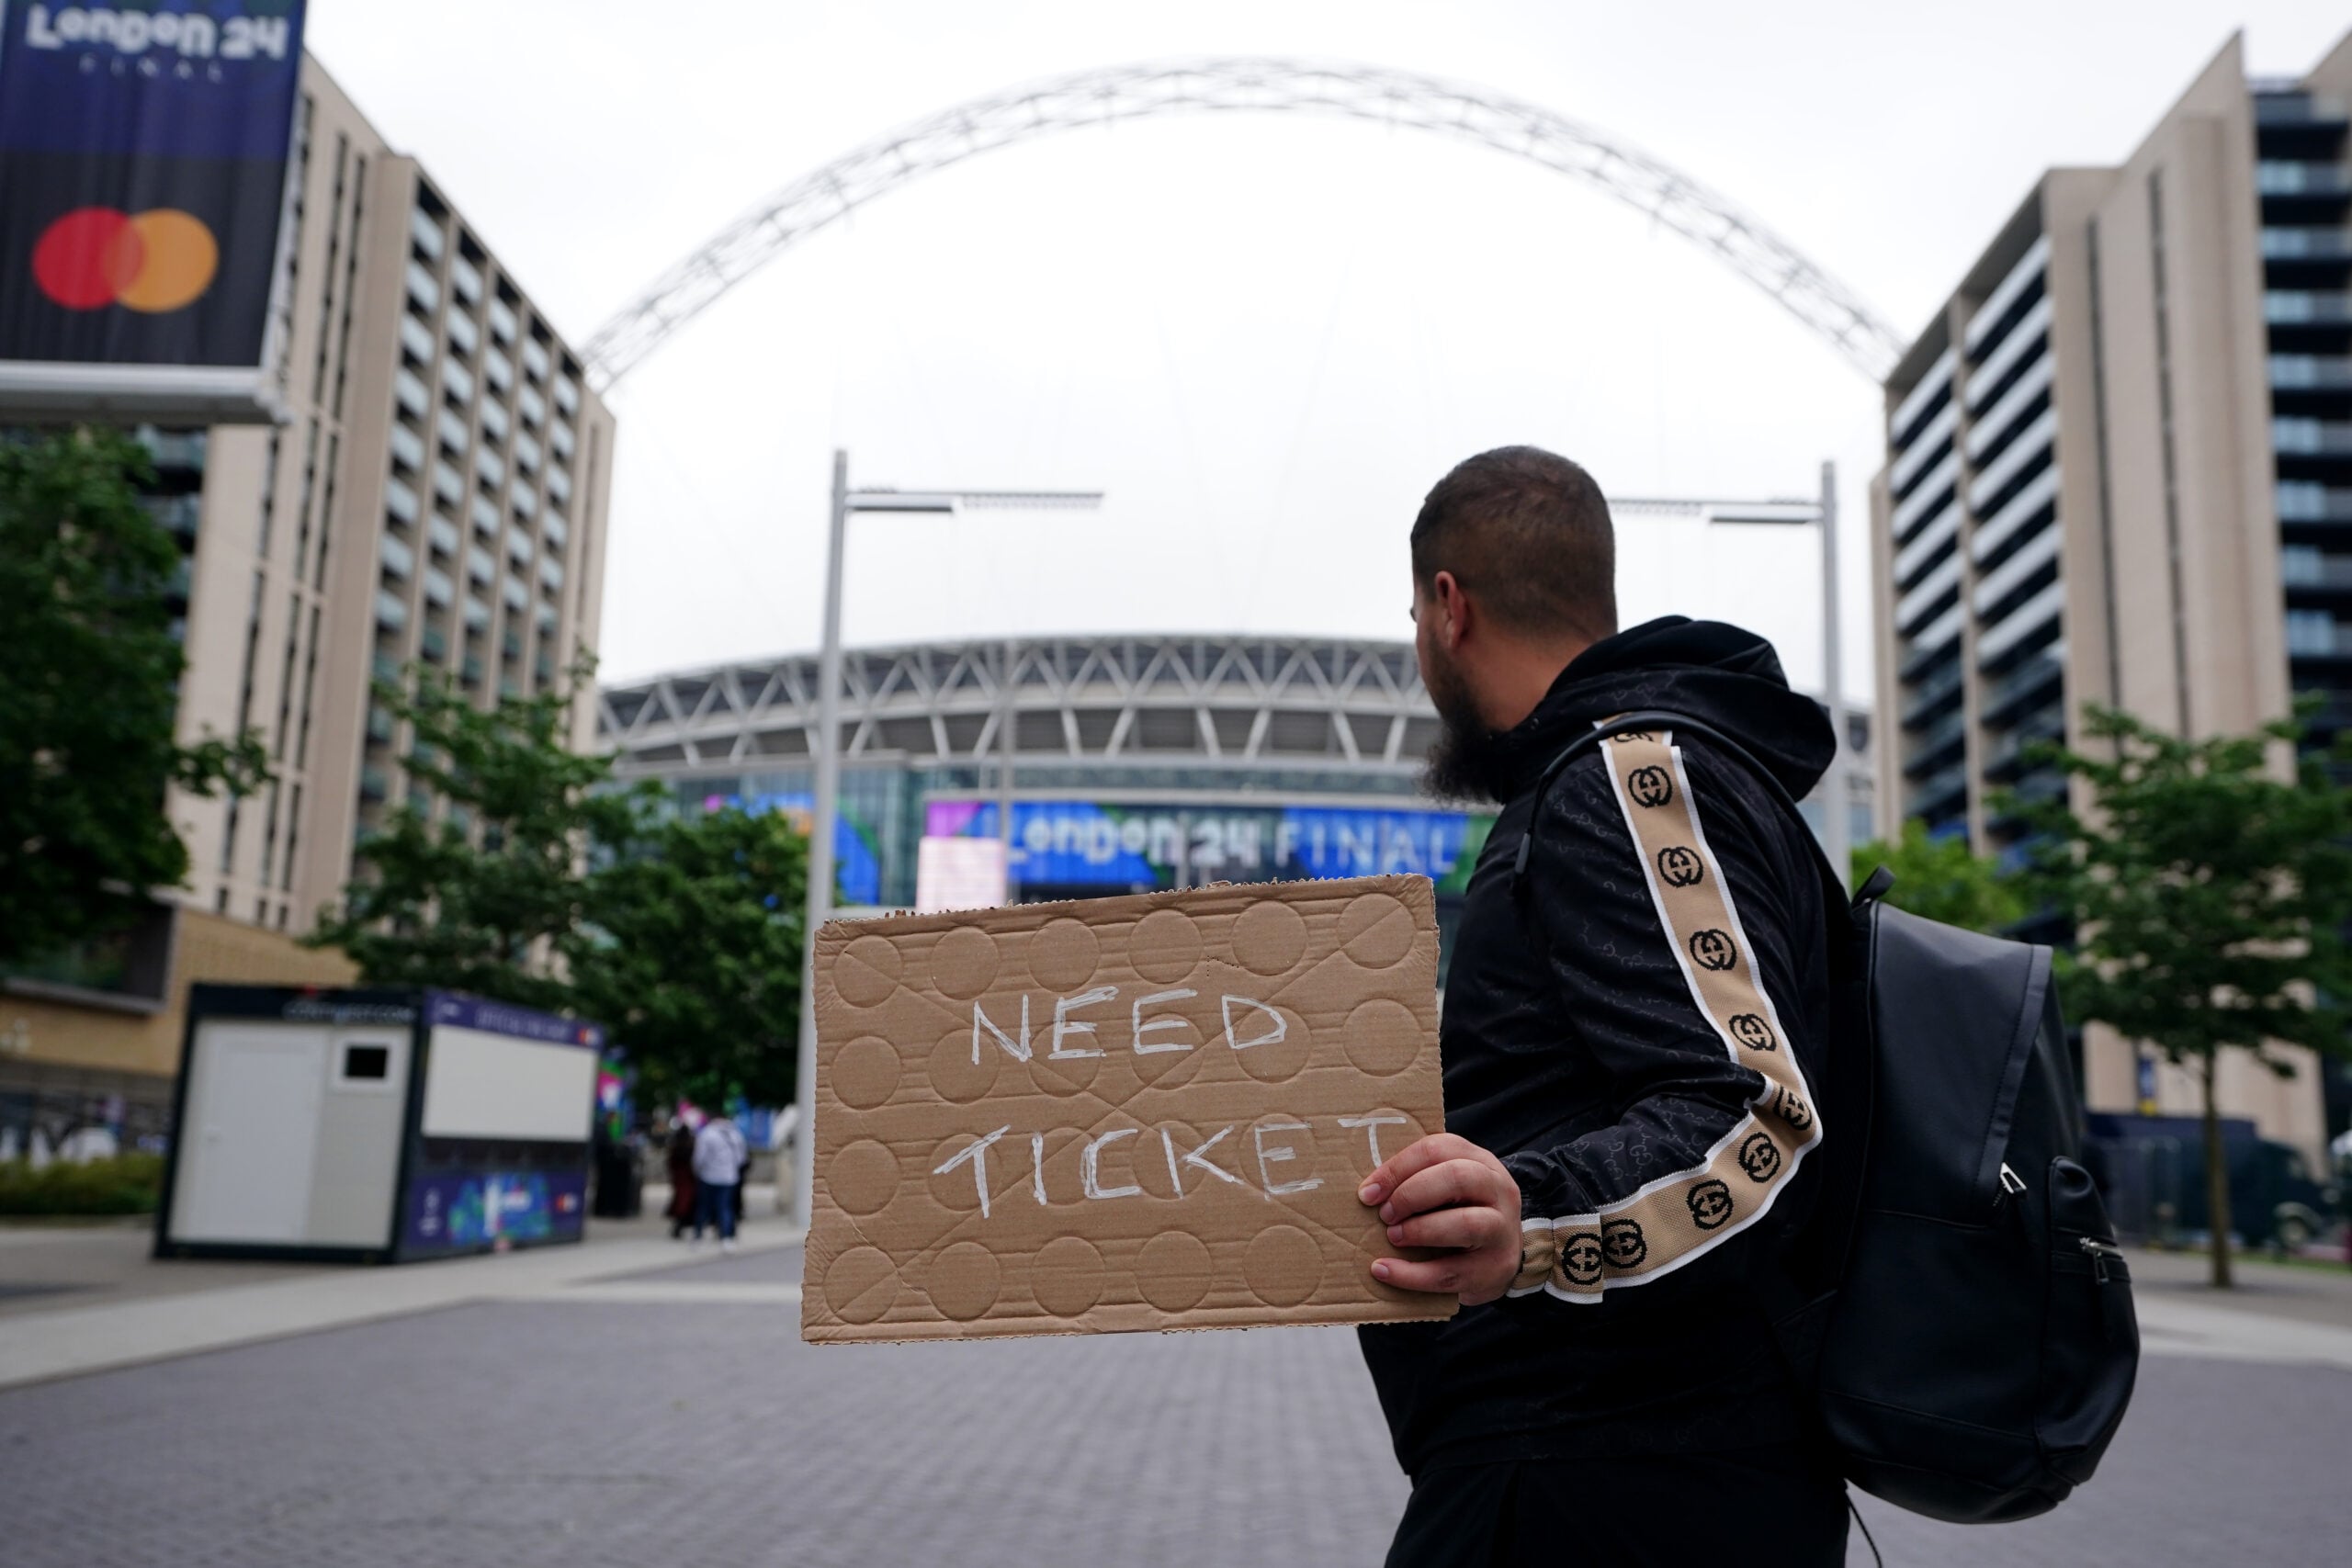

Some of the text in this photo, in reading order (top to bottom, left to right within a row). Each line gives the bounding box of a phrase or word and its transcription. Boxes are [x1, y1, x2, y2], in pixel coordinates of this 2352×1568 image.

[220, 16, 288, 60] 24
[1191, 817, 1261, 868] 24
[1274, 821, 1456, 872] FINAL
[971, 986, 1287, 1066] NEED
[933, 1115, 1408, 1219] TICKET
